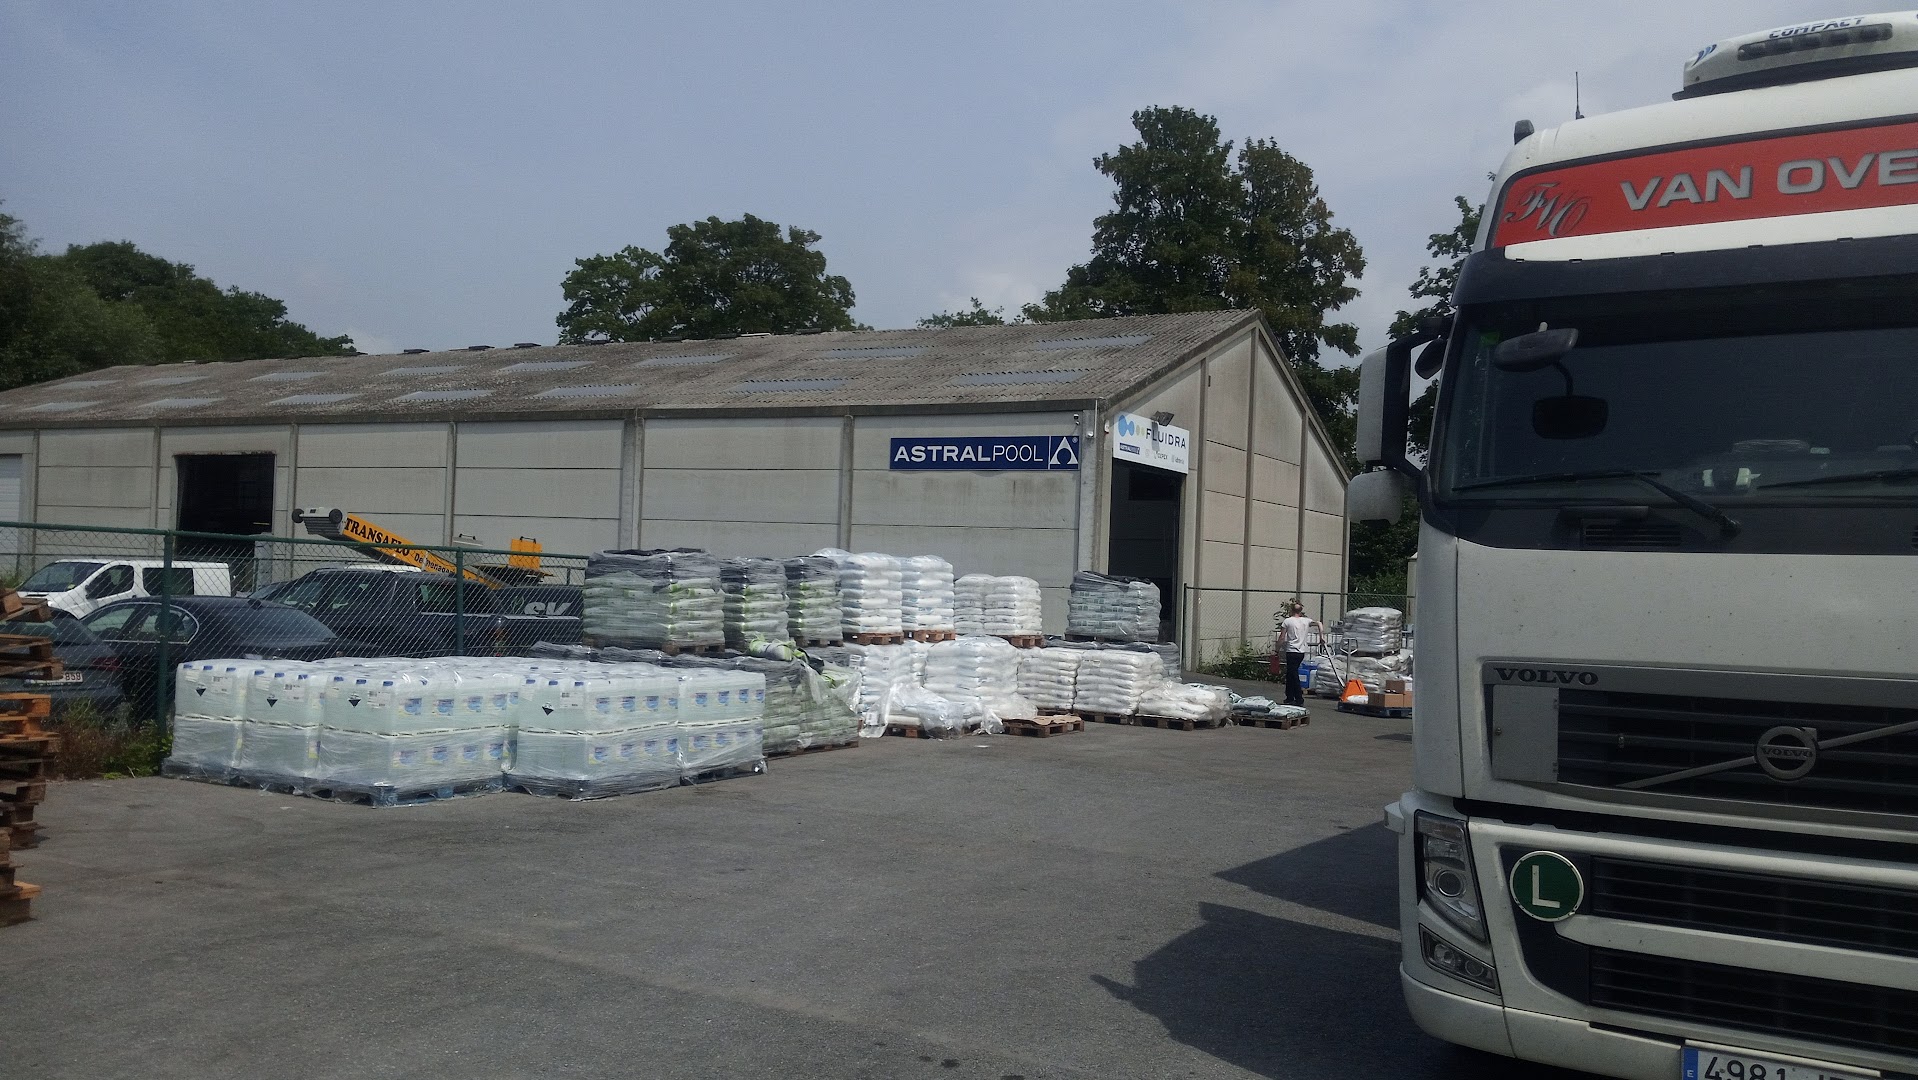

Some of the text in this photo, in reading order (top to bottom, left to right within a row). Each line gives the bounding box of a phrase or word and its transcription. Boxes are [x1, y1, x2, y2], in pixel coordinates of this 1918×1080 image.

[1768, 17, 1865, 39] COMPACT
[1620, 148, 1918, 211] VAN OVE
[1145, 427, 1187, 450] FLUIDRA
[894, 444, 1044, 463] ASTRALPOOL
[1494, 667, 1599, 686] VOLVO
[1760, 746, 1814, 758] VOLVO
[1531, 864, 1561, 909] L
